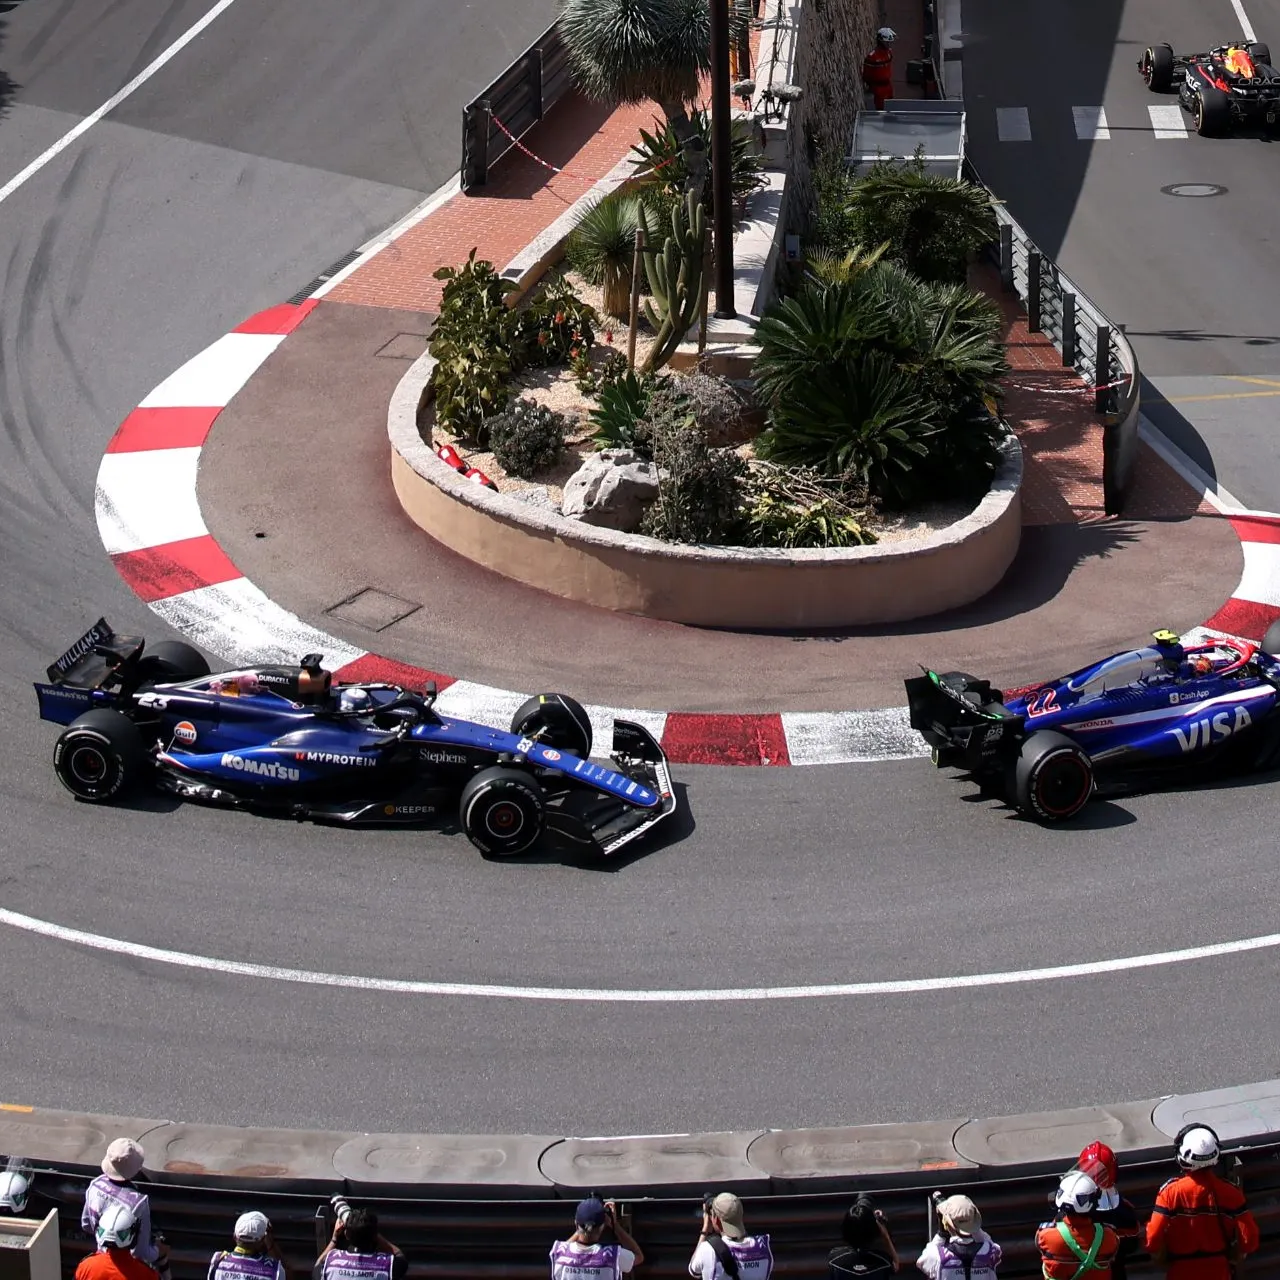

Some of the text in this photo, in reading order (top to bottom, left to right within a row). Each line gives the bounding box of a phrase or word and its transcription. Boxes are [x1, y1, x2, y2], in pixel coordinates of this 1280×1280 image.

[56, 628, 102, 673] WILLIAMS
[258, 674, 290, 686] DURACELL
[136, 694, 170, 711] 23
[1024, 687, 1062, 719] 22
[1179, 689, 1210, 702] Cash App
[174, 727, 197, 739] Gulf
[1078, 719, 1115, 731] HONDA
[1164, 705, 1254, 755] VISA
[516, 737, 535, 754] 23
[306, 751, 378, 768] MYPROTEIN
[418, 747, 468, 767] Stephens
[221, 752, 301, 782] KOMATSU
[395, 804, 436, 815] KEEPER
